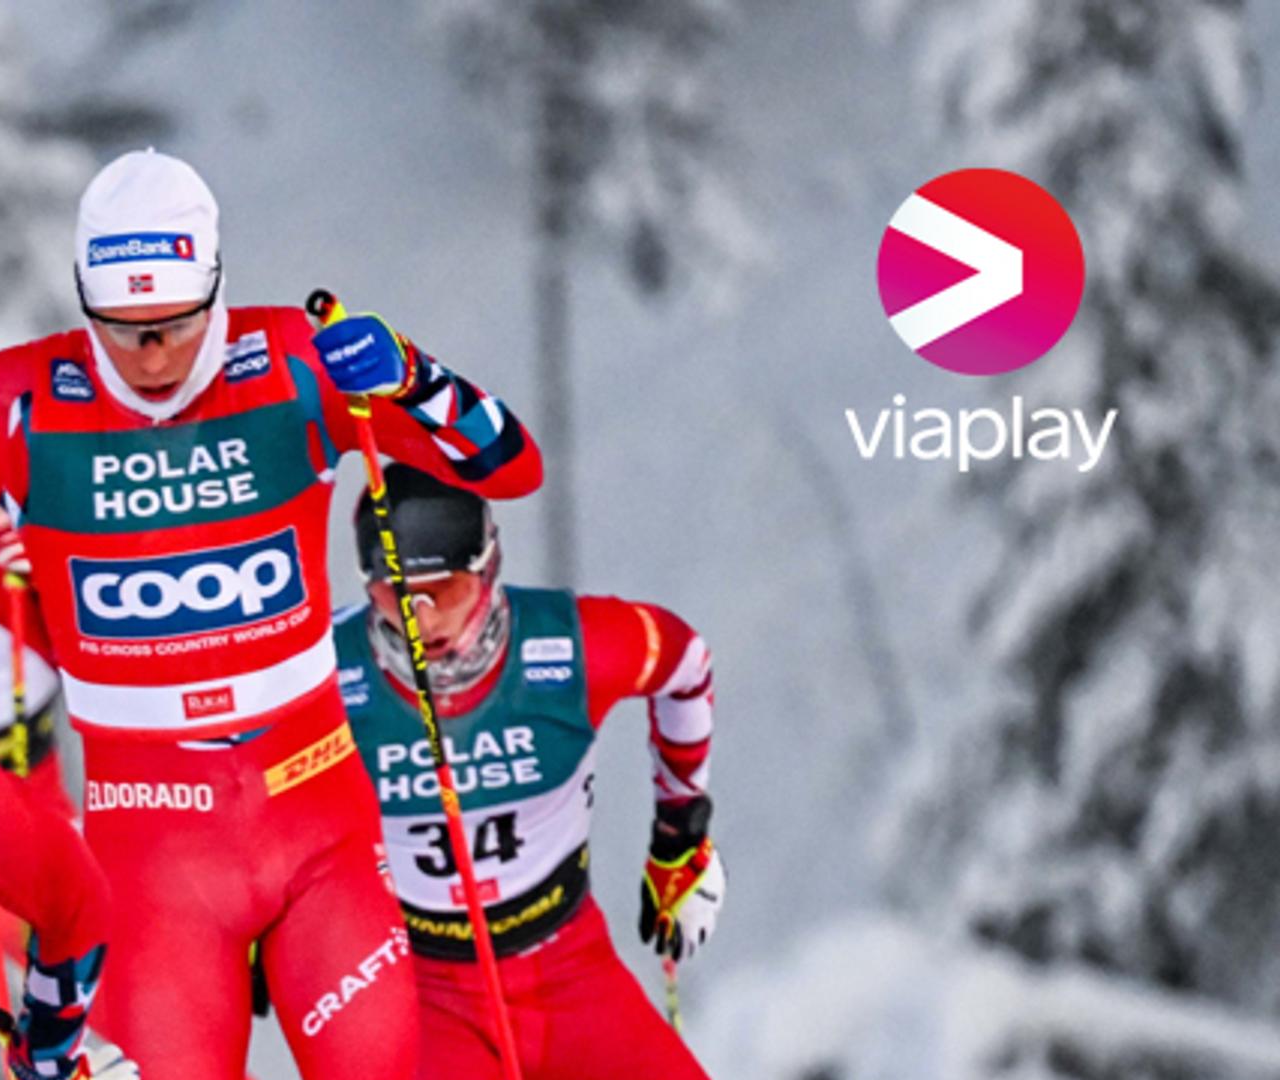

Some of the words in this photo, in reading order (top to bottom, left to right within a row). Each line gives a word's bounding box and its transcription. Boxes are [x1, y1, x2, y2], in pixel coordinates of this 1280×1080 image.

[178, 238, 190, 258] 1
[93, 438, 249, 484] POLAR
[94, 472, 259, 520] HOUSE
[81, 549, 292, 616] coop
[101, 641, 152, 657] CROSS
[154, 635, 230, 657] COUNTRY
[232, 621, 288, 644] WORLD
[377, 726, 536, 772] POLAR
[378, 757, 543, 802] HOUSE
[407, 810, 525, 878] 34
[301, 938, 401, 1037] CRAFT
